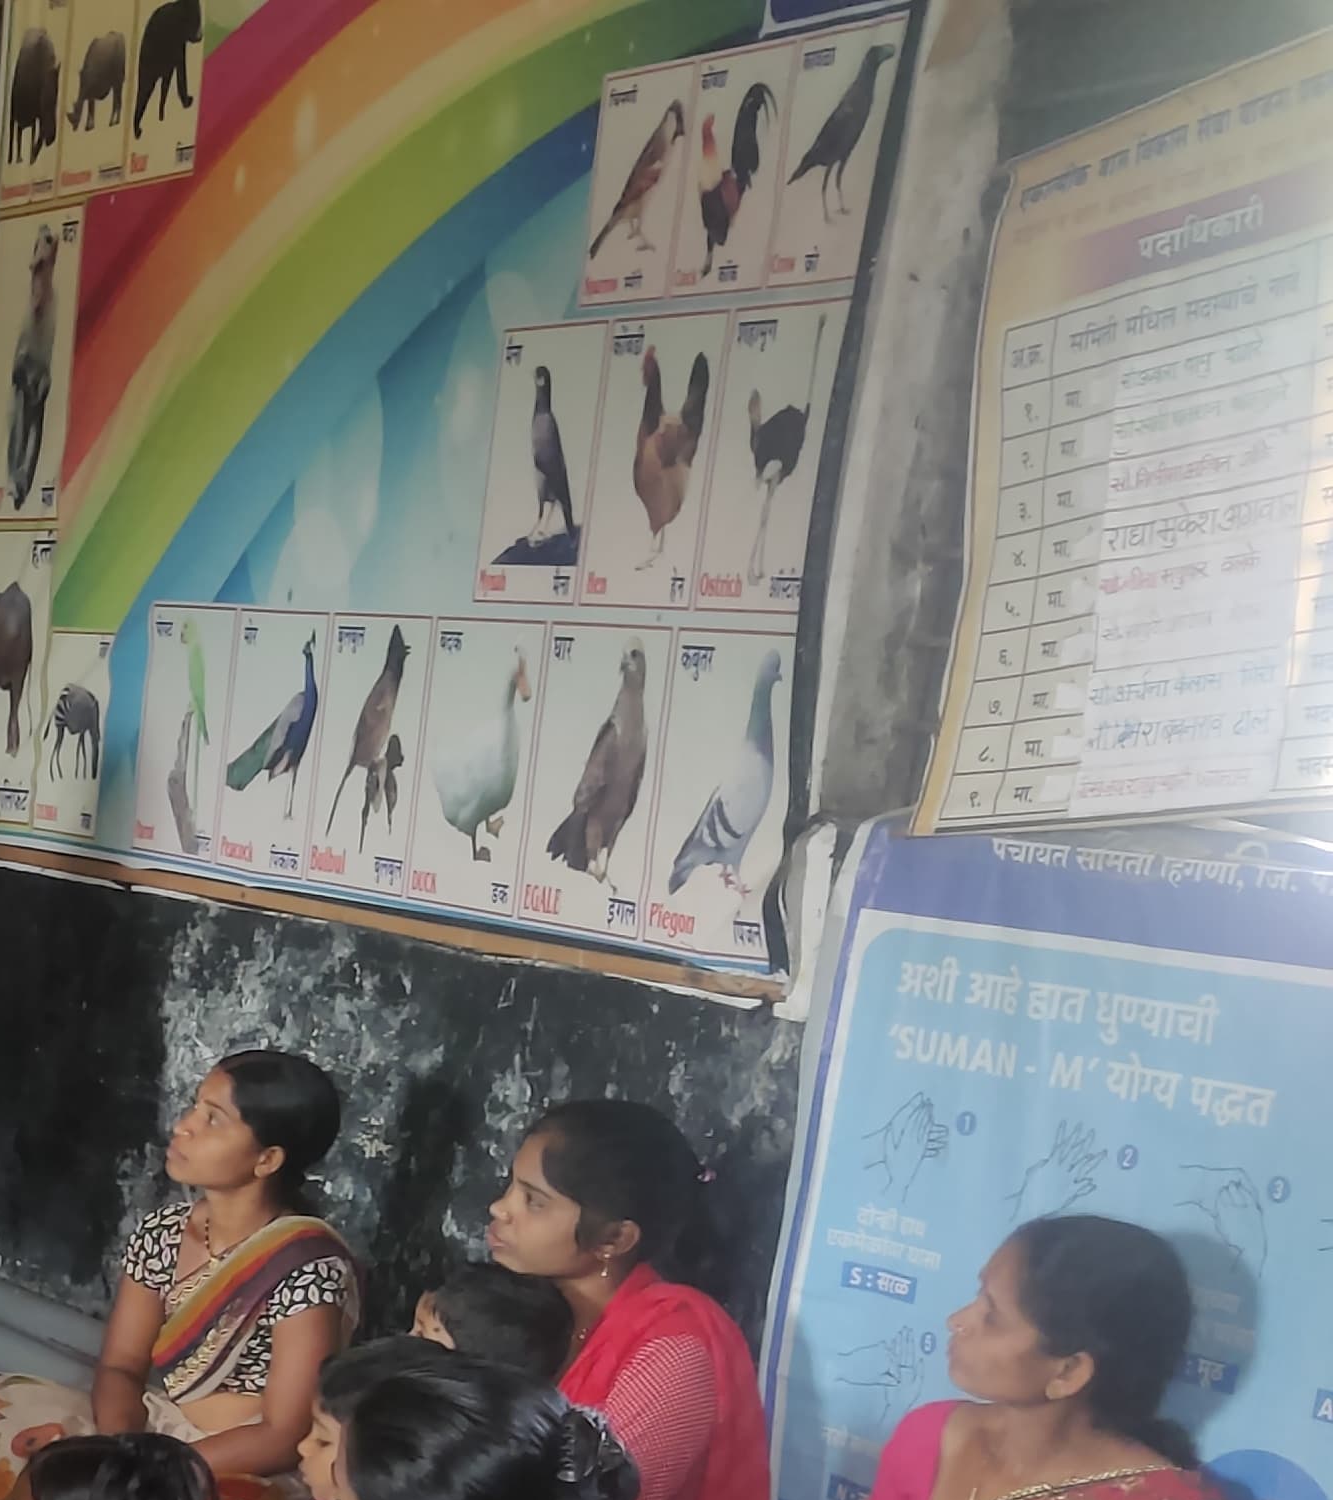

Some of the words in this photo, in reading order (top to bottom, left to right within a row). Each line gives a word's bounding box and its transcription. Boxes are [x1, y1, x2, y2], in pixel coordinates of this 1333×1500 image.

[1138, 195, 1265, 261] पदाधिकारी
[700, 572, 743, 598] Ostrich
[523, 884, 563, 916] EGALE
[649, 902, 695, 939] Piegon
[897, 956, 958, 1005] अशी
[968, 965, 1020, 1017] आहे
[1095, 990, 1220, 1048] धुण्याची
[1106, 1055, 1180, 1112] योग्य
[1190, 1076, 1278, 1130] पद्धत
[961, 1114, 973, 1131] 1
[1122, 1148, 1134, 1167] 2
[1272, 1180, 1285, 1198] 3
[849, 1266, 863, 1286] S
